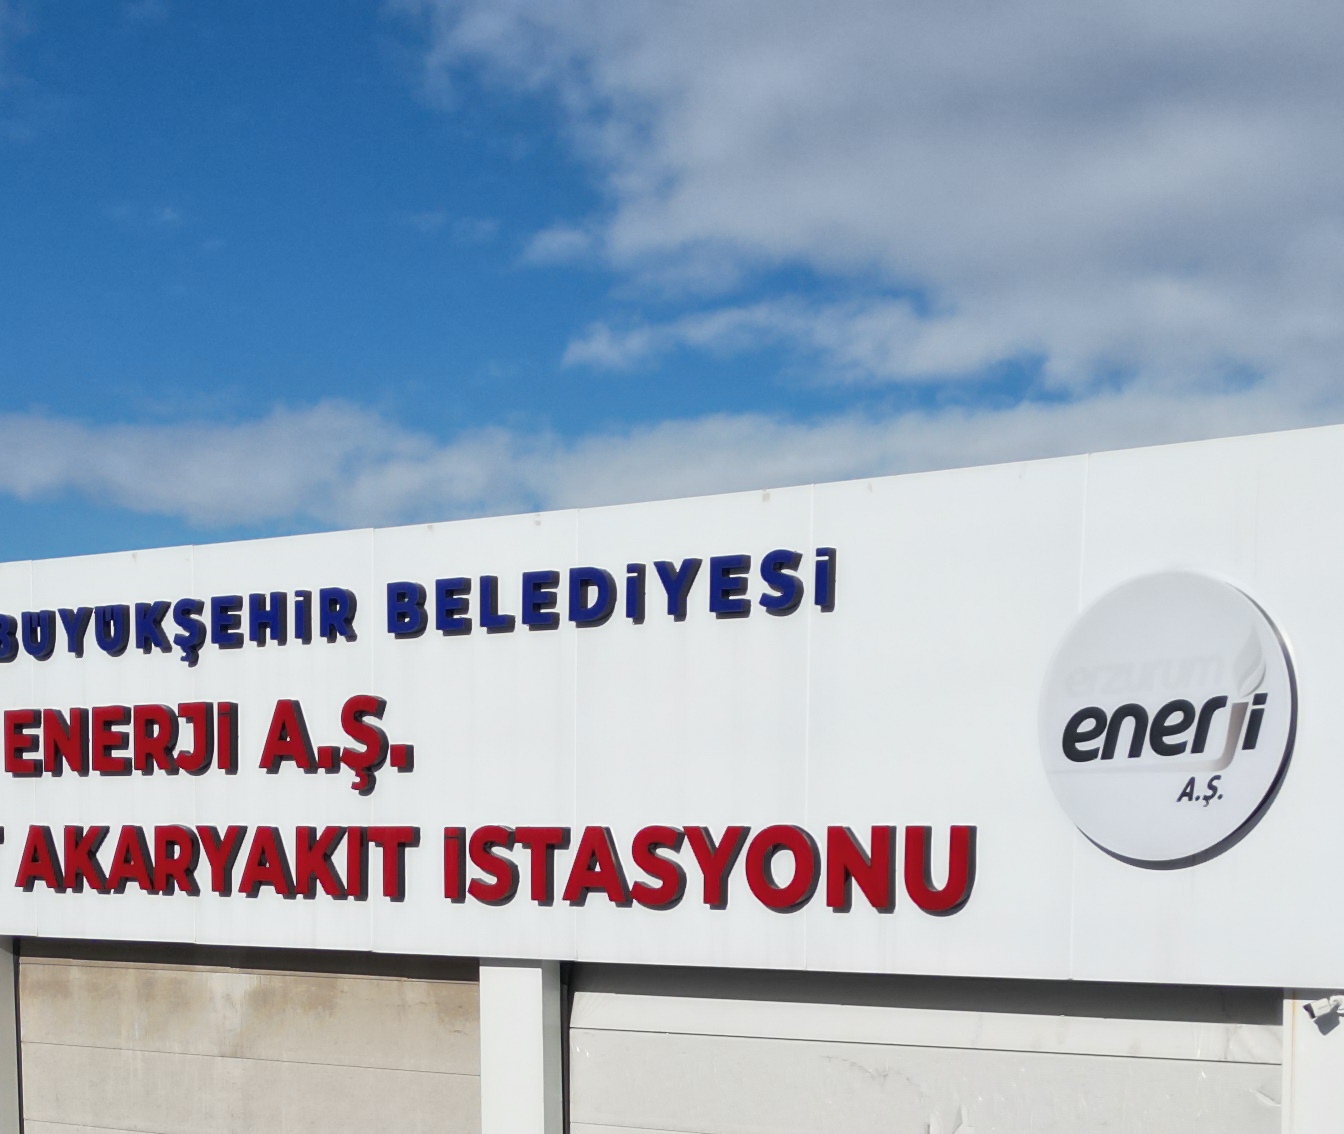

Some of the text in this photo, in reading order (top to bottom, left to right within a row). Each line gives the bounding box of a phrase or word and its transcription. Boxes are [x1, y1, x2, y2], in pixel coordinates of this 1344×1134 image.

[386, 547, 837, 640] BELEDİYESİ
[3, 694, 415, 796] ENERJİ A.Ş.
[1062, 692, 1268, 772] enerji
[1176, 775, 1224, 807] A.Ş.
[14, 824, 420, 902] AKARYAKIT
[443, 824, 977, 917] İSTASYONU
